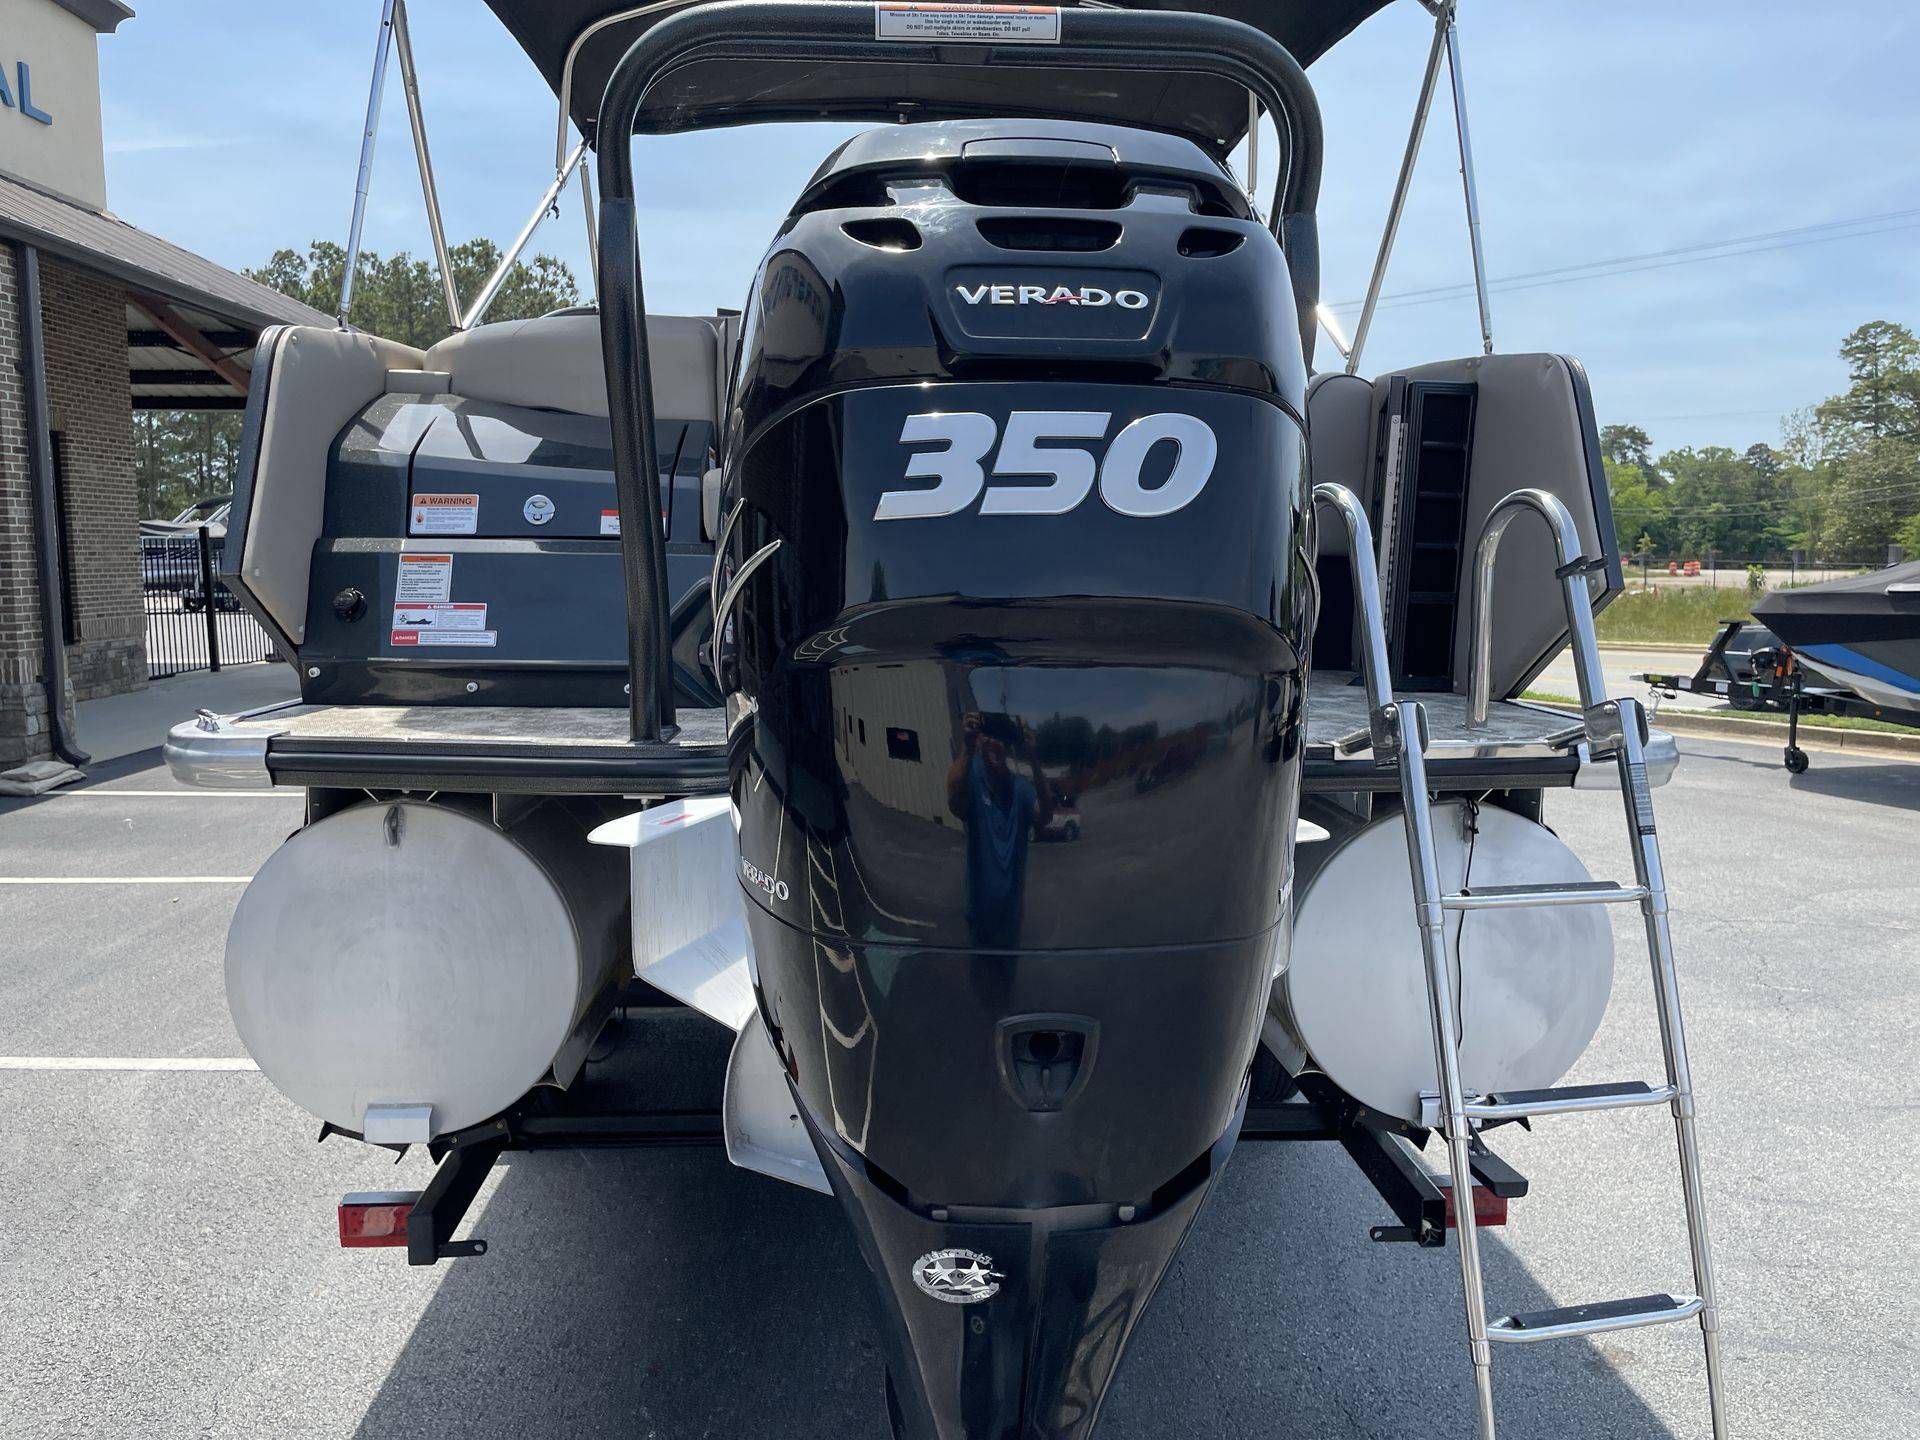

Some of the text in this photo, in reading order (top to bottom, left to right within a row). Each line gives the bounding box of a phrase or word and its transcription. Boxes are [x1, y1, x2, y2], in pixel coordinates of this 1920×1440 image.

[956, 284, 1149, 309] VERADO
[873, 411, 1218, 521] 350
[429, 497, 472, 505] WARNING
